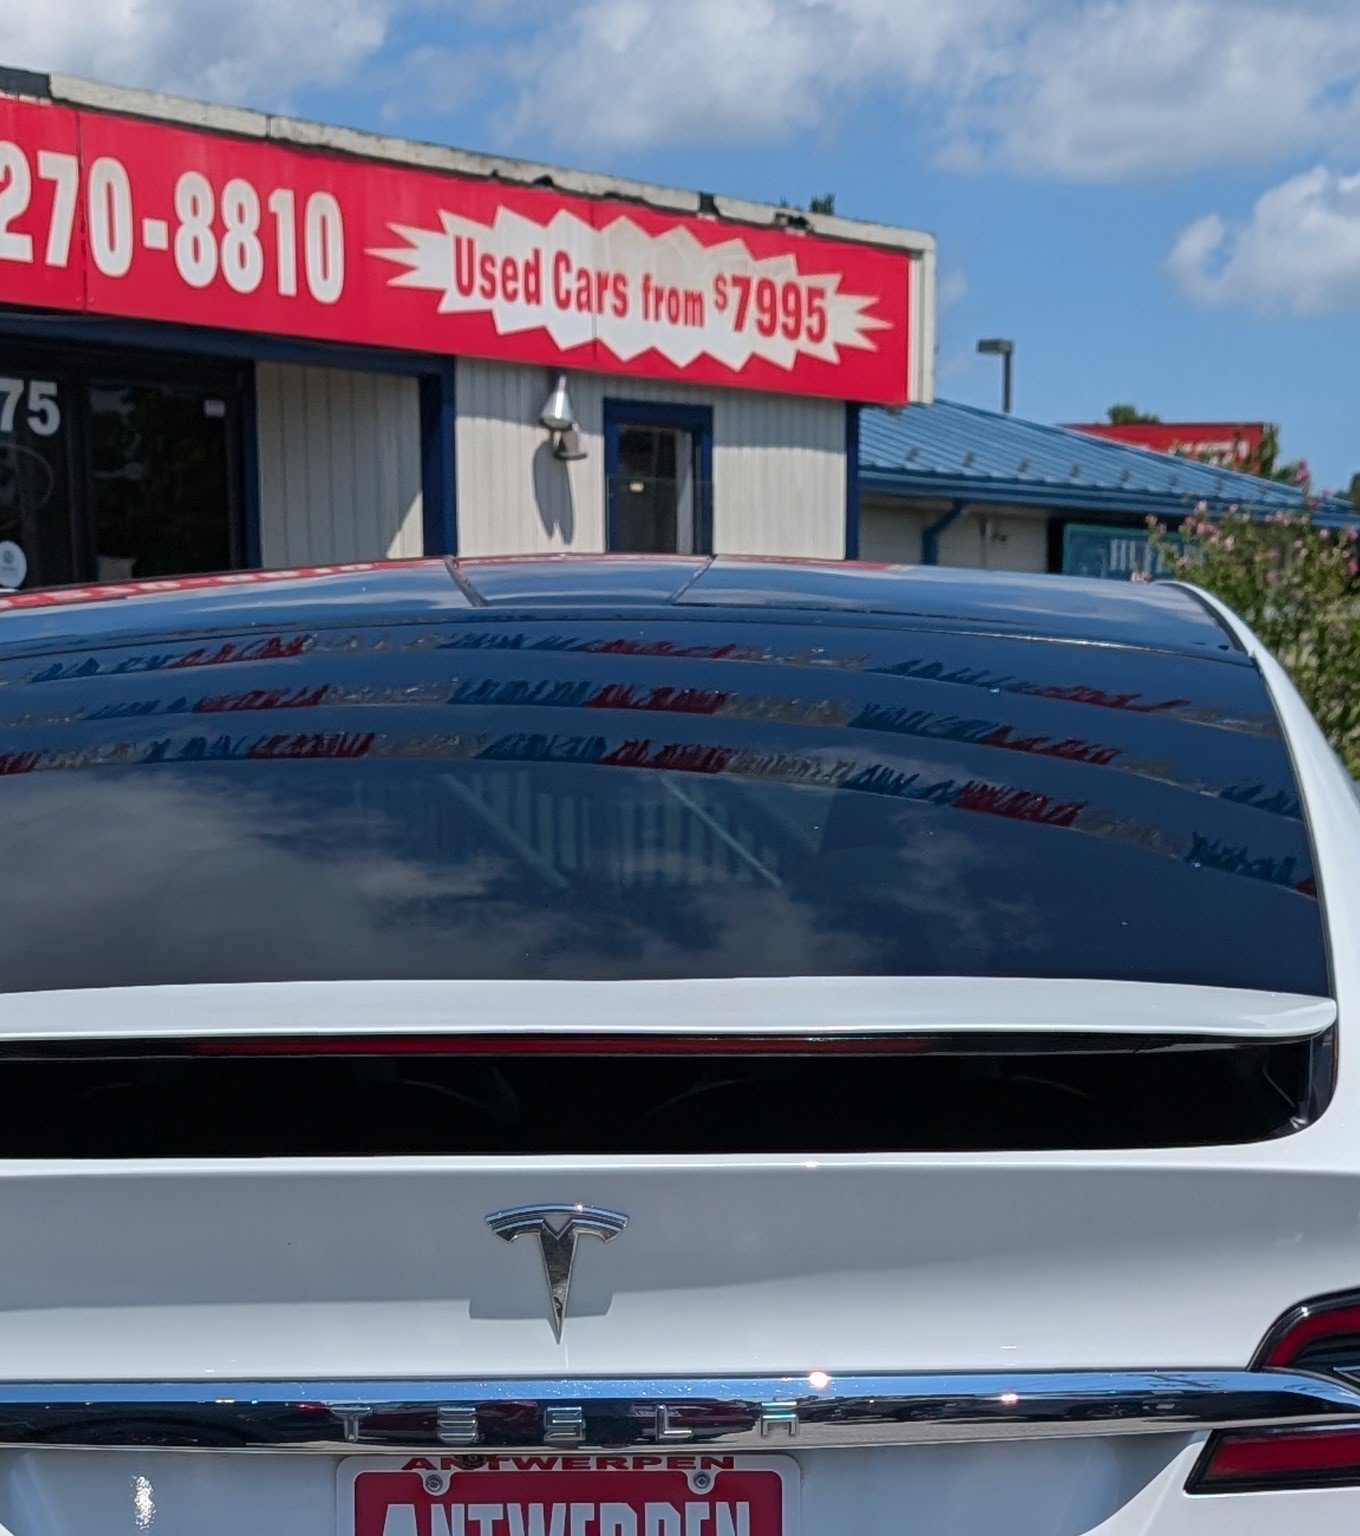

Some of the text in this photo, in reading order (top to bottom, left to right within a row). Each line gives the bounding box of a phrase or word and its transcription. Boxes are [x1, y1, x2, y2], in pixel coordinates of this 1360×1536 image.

[453, 235, 828, 344] Used Cars from $7995
[401, 1455, 735, 1471] ANTWERPEN
